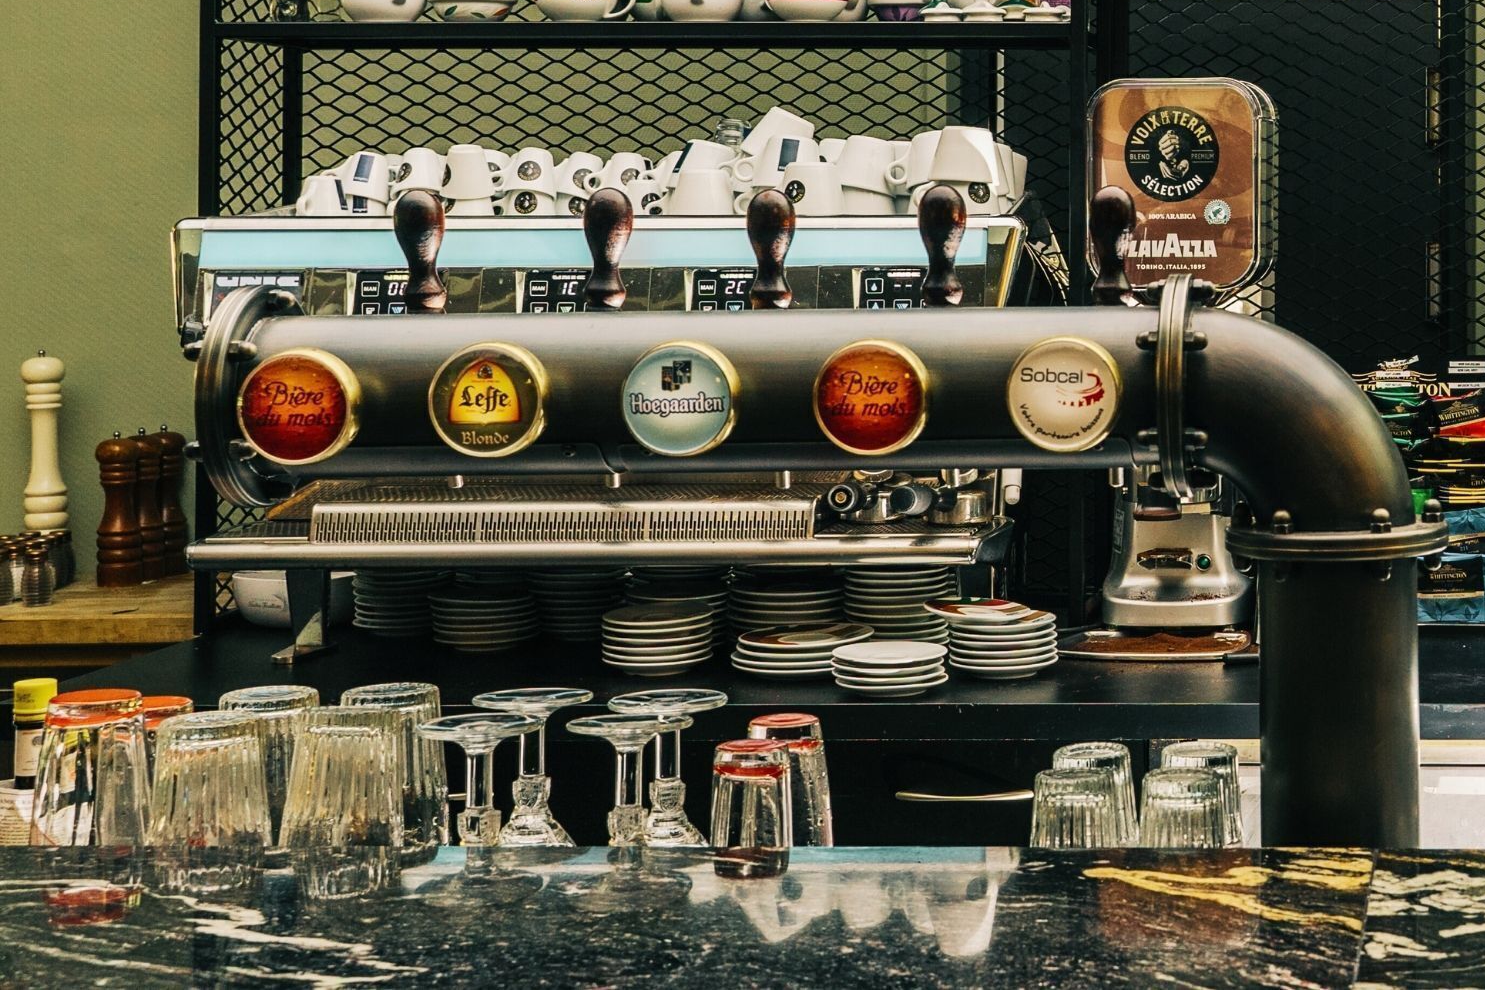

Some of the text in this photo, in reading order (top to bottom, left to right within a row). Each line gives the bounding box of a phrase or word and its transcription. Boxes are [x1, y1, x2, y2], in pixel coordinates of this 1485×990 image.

[1131, 114, 1161, 145] VOIX
[1171, 111, 1213, 145] TERRE
[1141, 174, 1205, 197] SÉLECTION
[1128, 232, 1218, 258] LAVAZZA
[839, 370, 899, 397] Bière
[1020, 367, 1083, 384] Sobcal
[264, 380, 324, 407] Bière
[458, 385, 512, 414] Leffe
[629, 393, 724, 418] Hoegaarden
[257, 406, 283, 427] du
[831, 396, 907, 418] du mois
[1438, 405, 1480, 422] WHITTINGTON
[461, 431, 510, 445] Blonde
